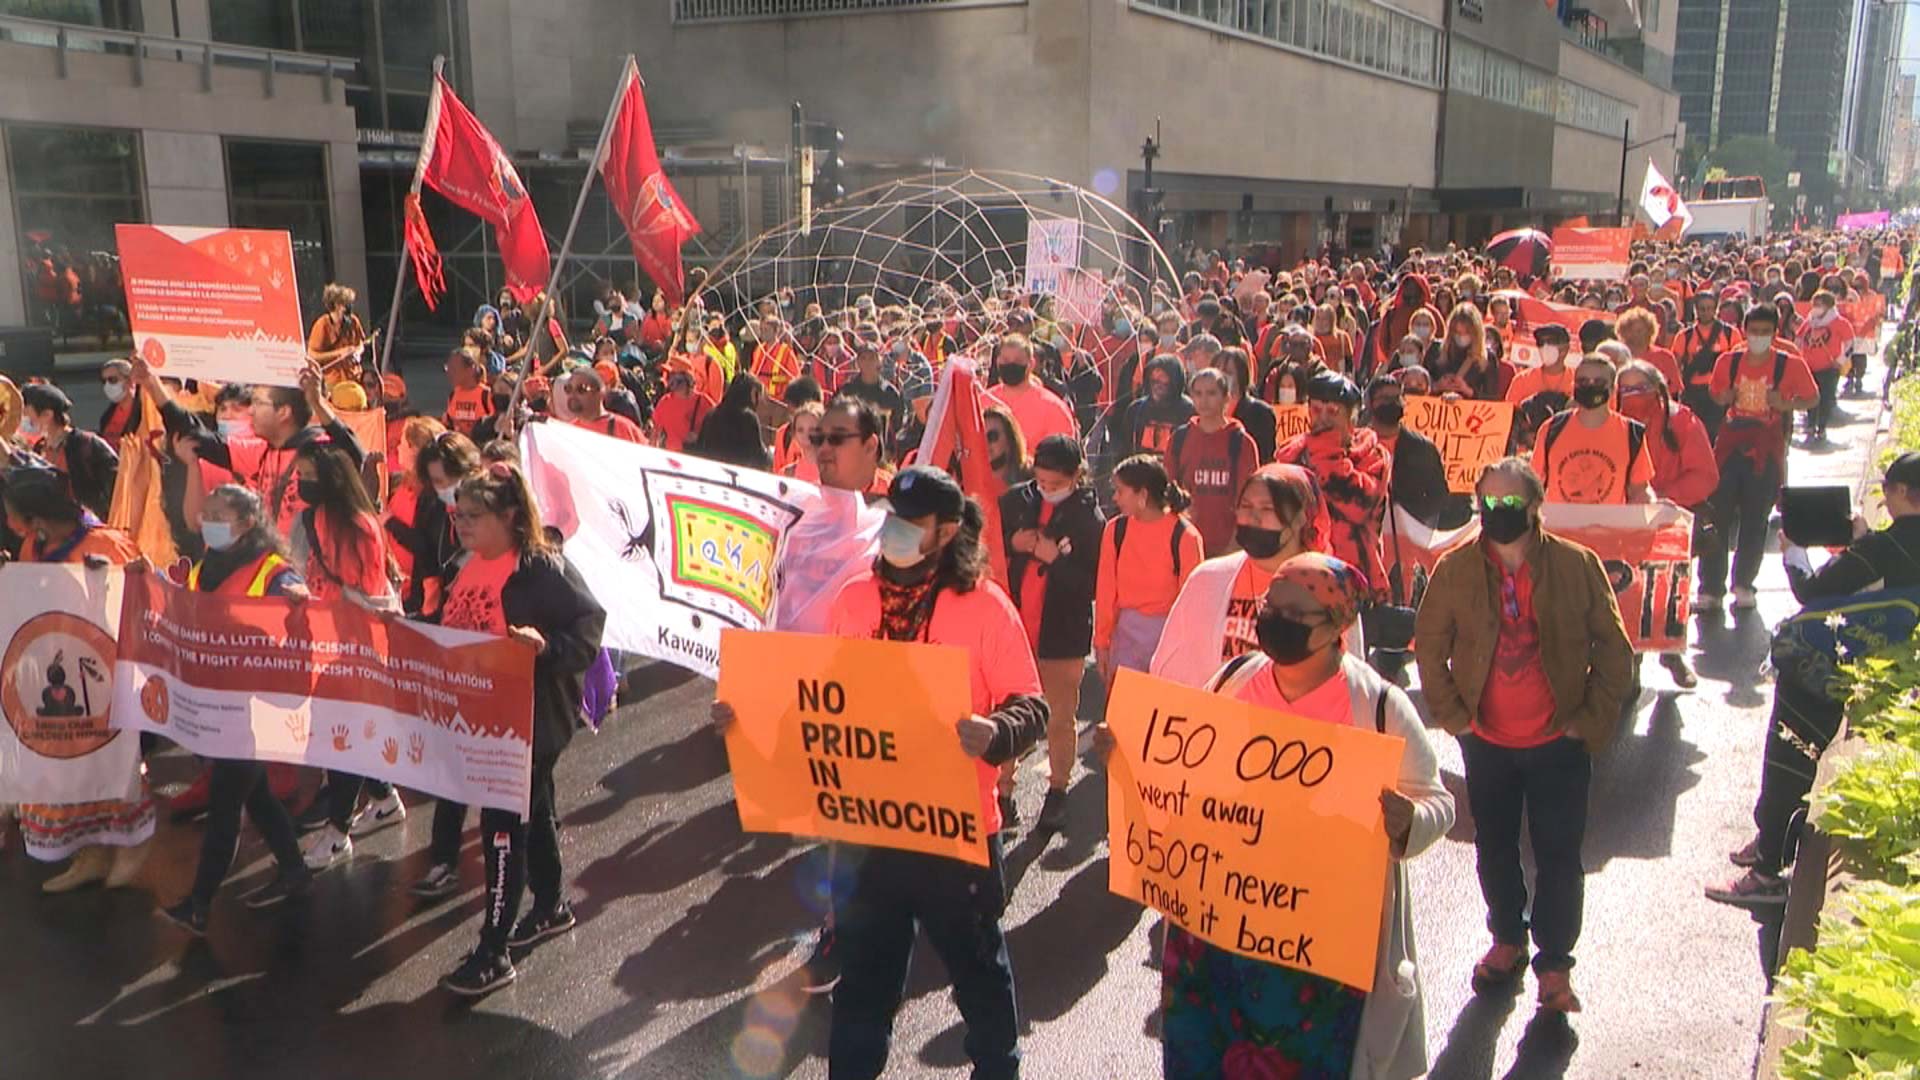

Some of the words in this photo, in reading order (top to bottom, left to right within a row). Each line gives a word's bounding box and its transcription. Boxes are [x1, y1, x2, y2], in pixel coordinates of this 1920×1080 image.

[1414, 401, 1462, 432] SUIS
[180, 625, 208, 643] DANS
[210, 631, 226, 646] LA
[230, 633, 277, 648] LUTTE
[279, 635, 298, 649] AU
[300, 638, 358, 656] RACISME
[446, 671, 493, 690] NATIONS
[199, 652, 239, 668] FIGHT
[243, 655, 302, 672] AGAINST
[304, 662, 353, 678] RACISM
[397, 680, 423, 695] FIRST
[424, 686, 459, 708] NATIONS
[797, 678, 846, 715] NO
[801, 721, 898, 763] PRIDE
[1142, 708, 1217, 769] 150
[1236, 735, 1334, 788] 000
[807, 757, 843, 790] IN
[816, 791, 978, 844] GENOCIDE
[1137, 779, 1190, 817] went
[1202, 797, 1265, 846] away
[1223, 870, 1310, 912] never
[1140, 877, 1190, 927] made
[1199, 901, 1220, 936] it
[1236, 914, 1314, 967] back
